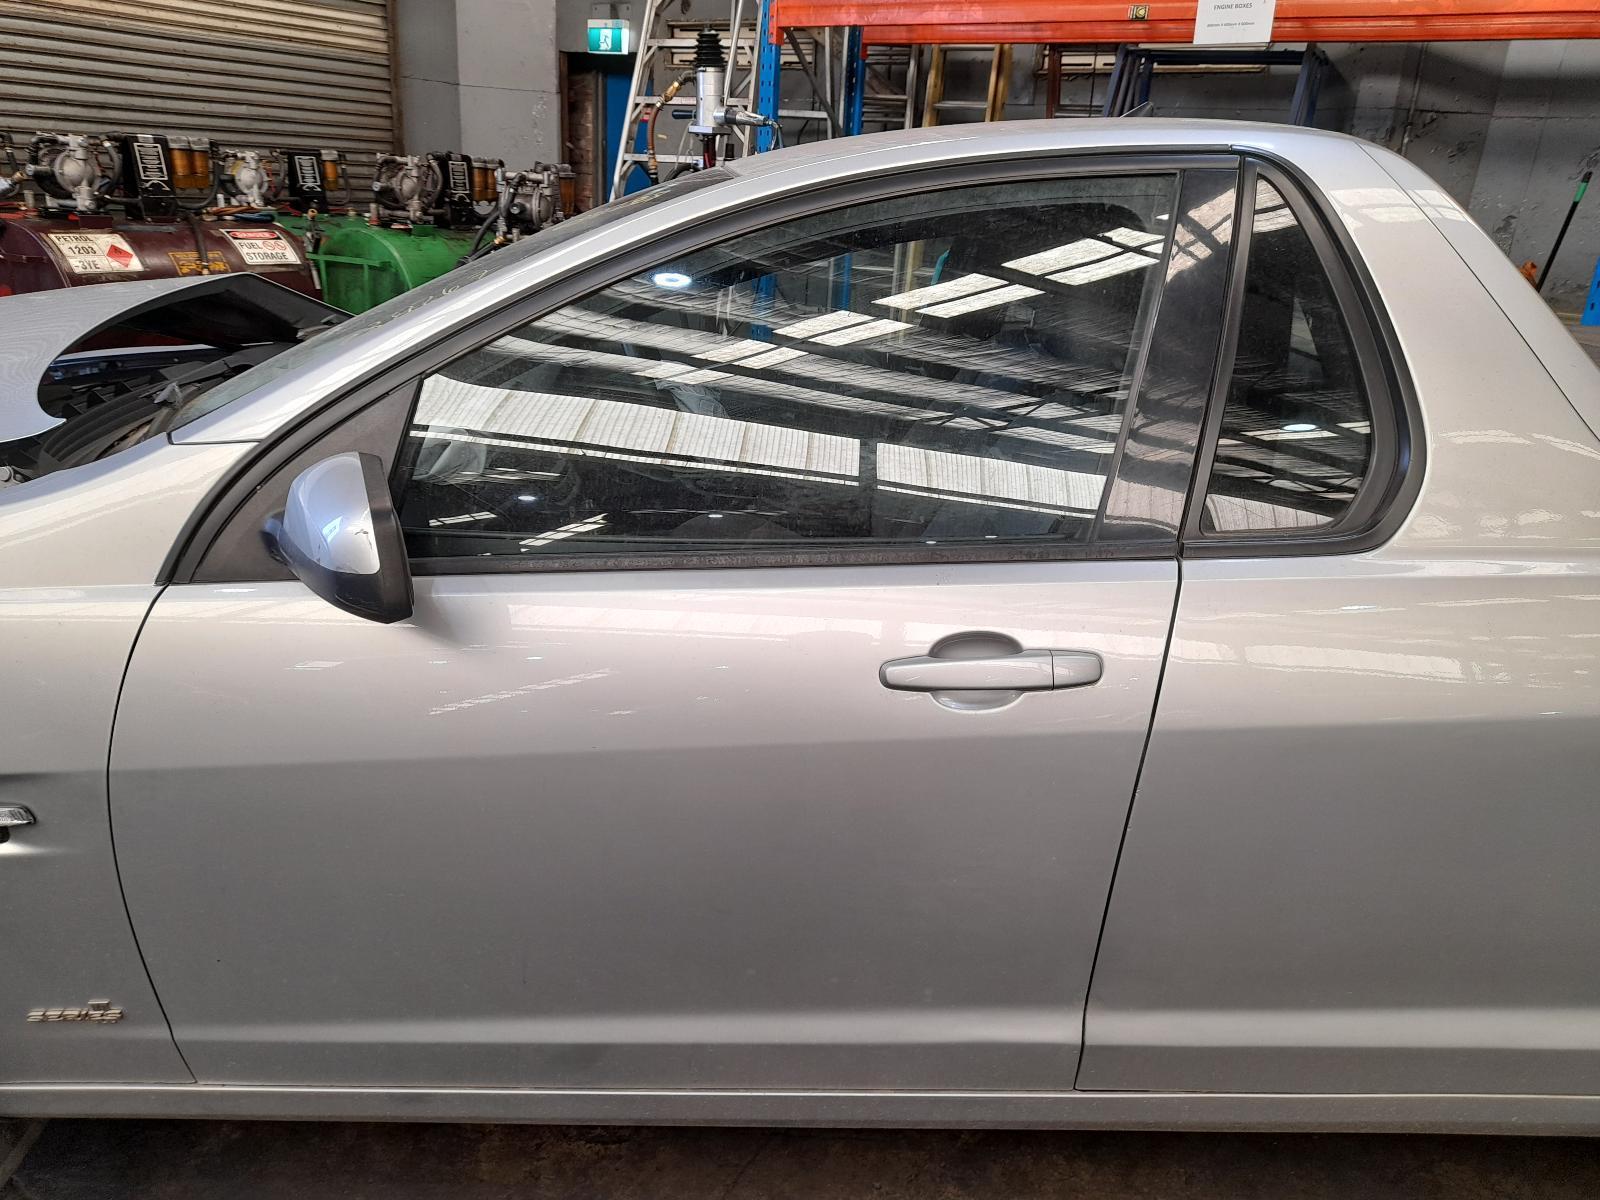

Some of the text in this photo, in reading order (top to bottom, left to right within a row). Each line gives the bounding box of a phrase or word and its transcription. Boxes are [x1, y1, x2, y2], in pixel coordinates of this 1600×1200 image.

[68, 245, 97, 255] 1203
[240, 242, 263, 250] FUEL
[245, 252, 289, 260] STORAGE
